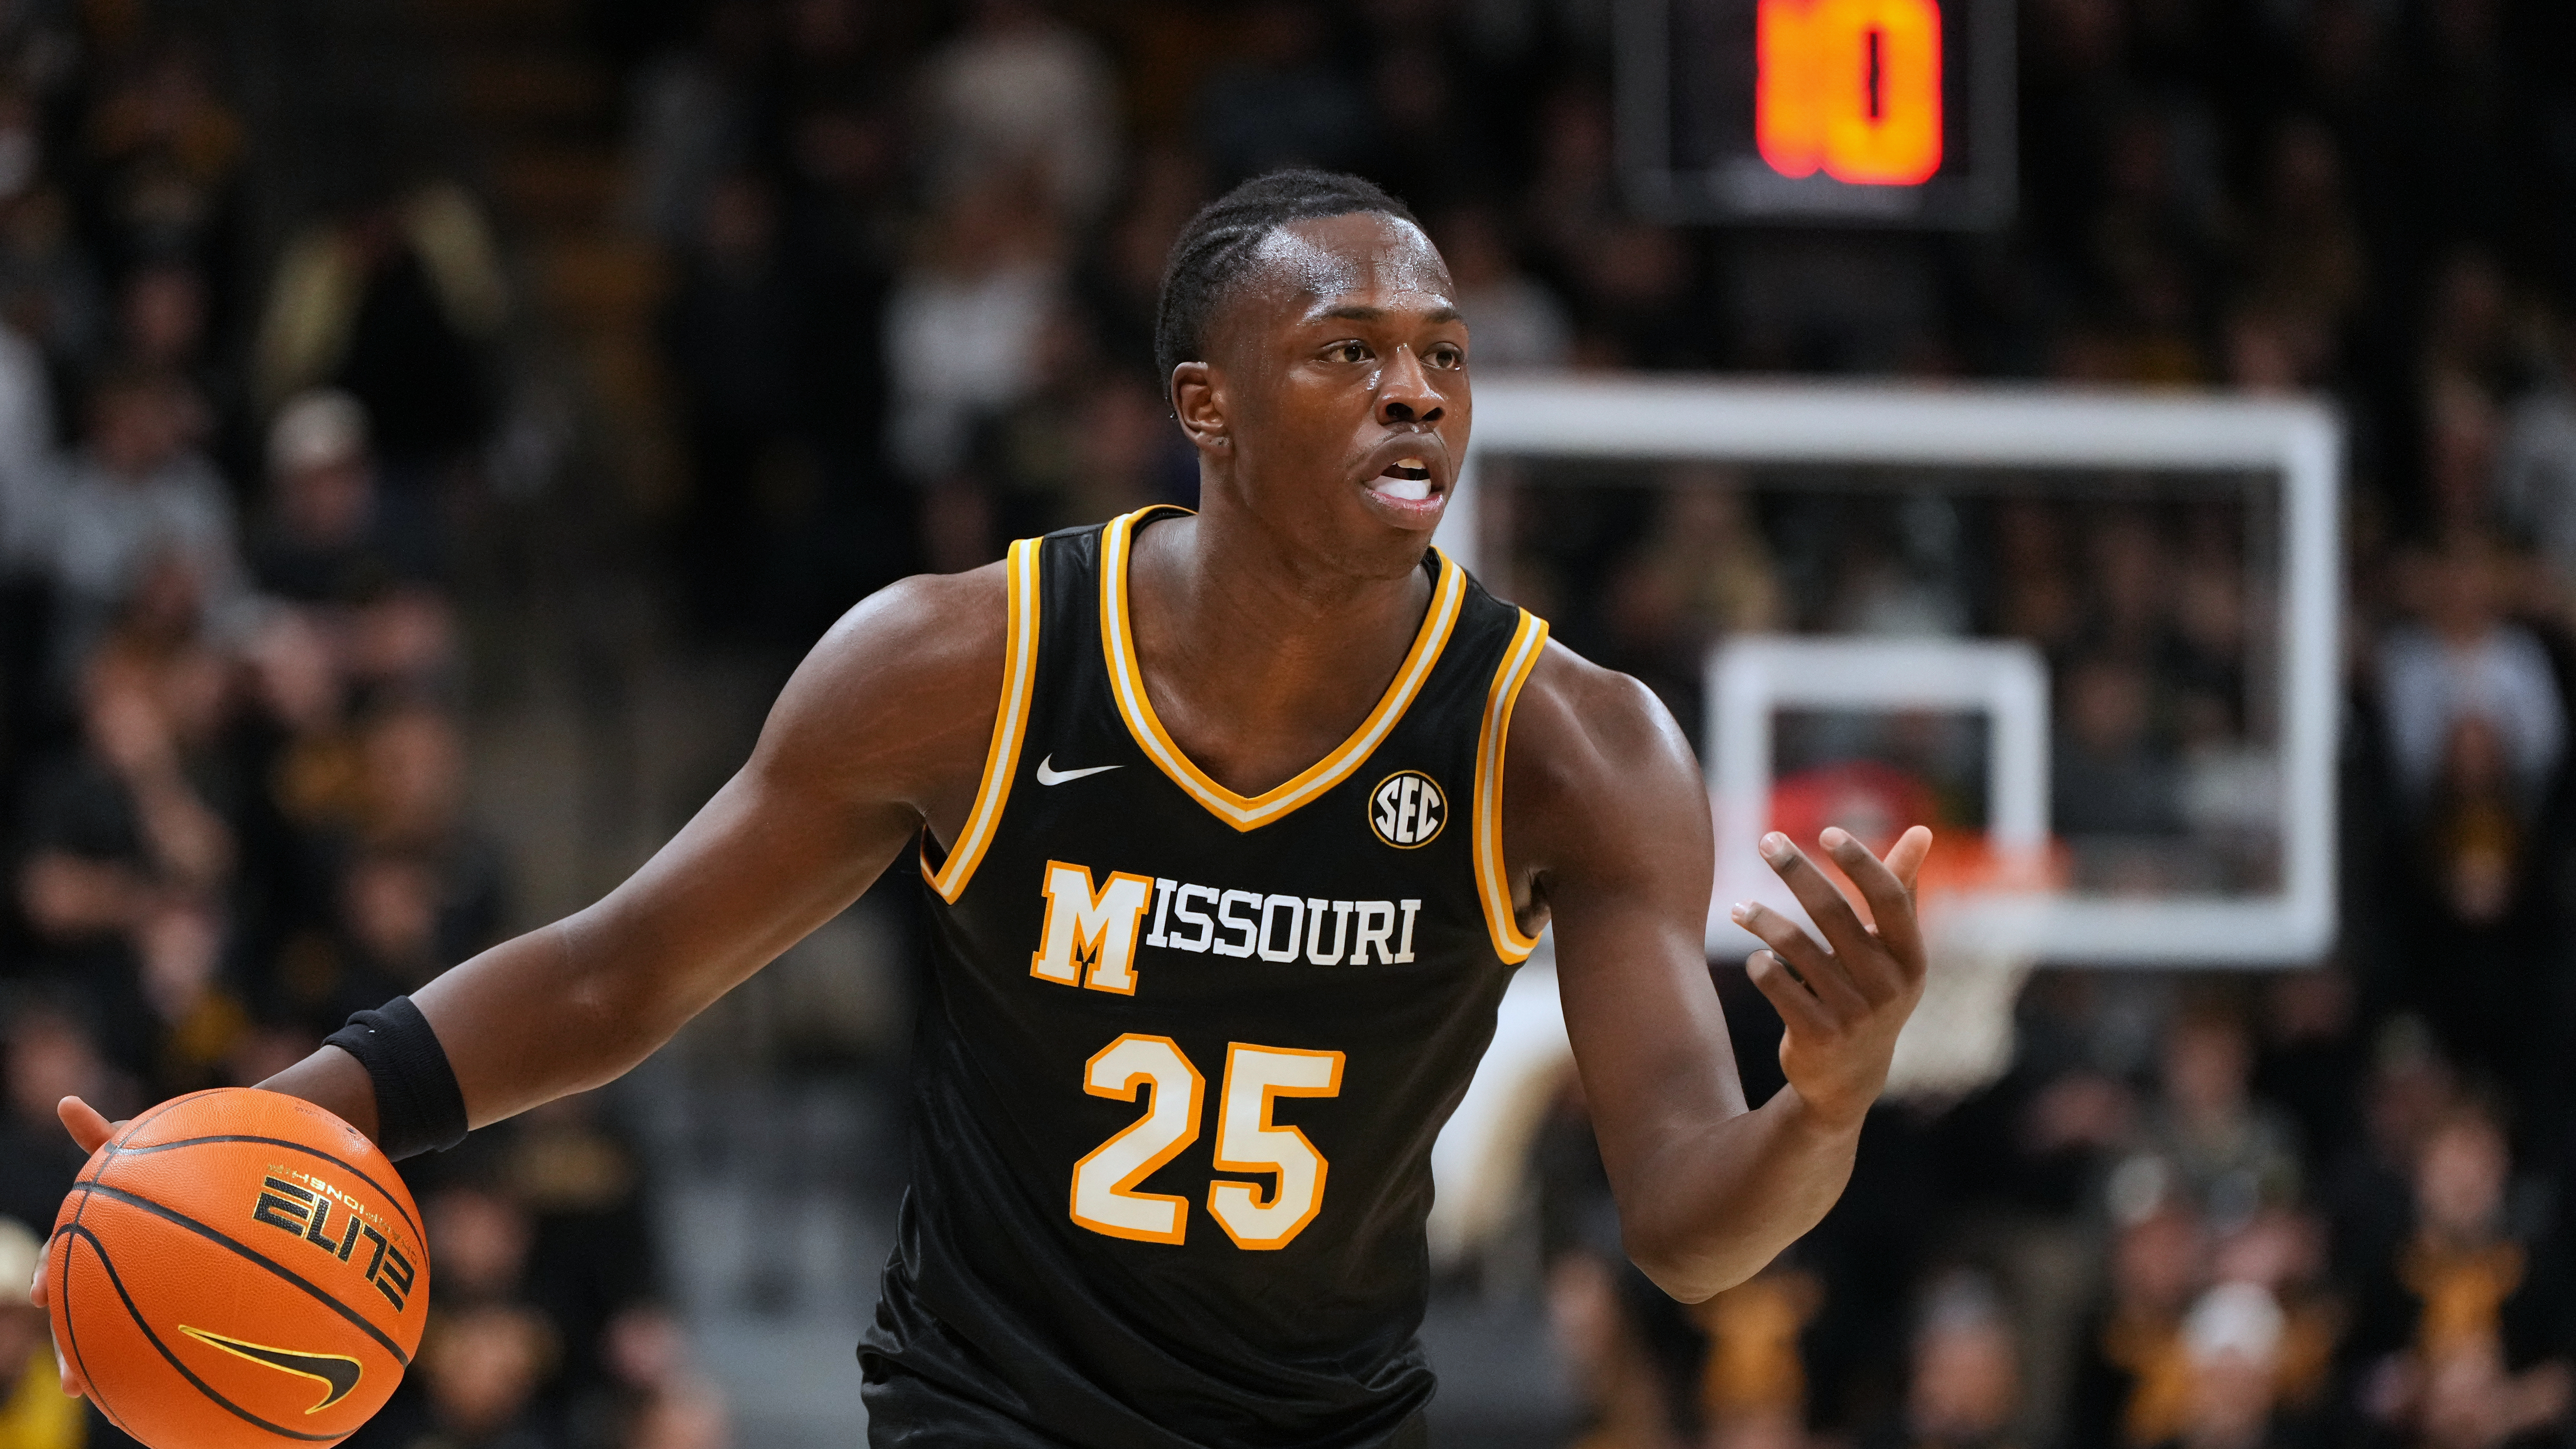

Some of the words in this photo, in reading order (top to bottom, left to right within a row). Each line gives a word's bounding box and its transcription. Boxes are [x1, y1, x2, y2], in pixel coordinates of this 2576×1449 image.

[1376, 776, 1440, 843] SEC
[1029, 859, 1422, 996] MISSOURI
[1070, 1033, 1346, 1250] 25
[252, 1175, 415, 1314] ELITE
